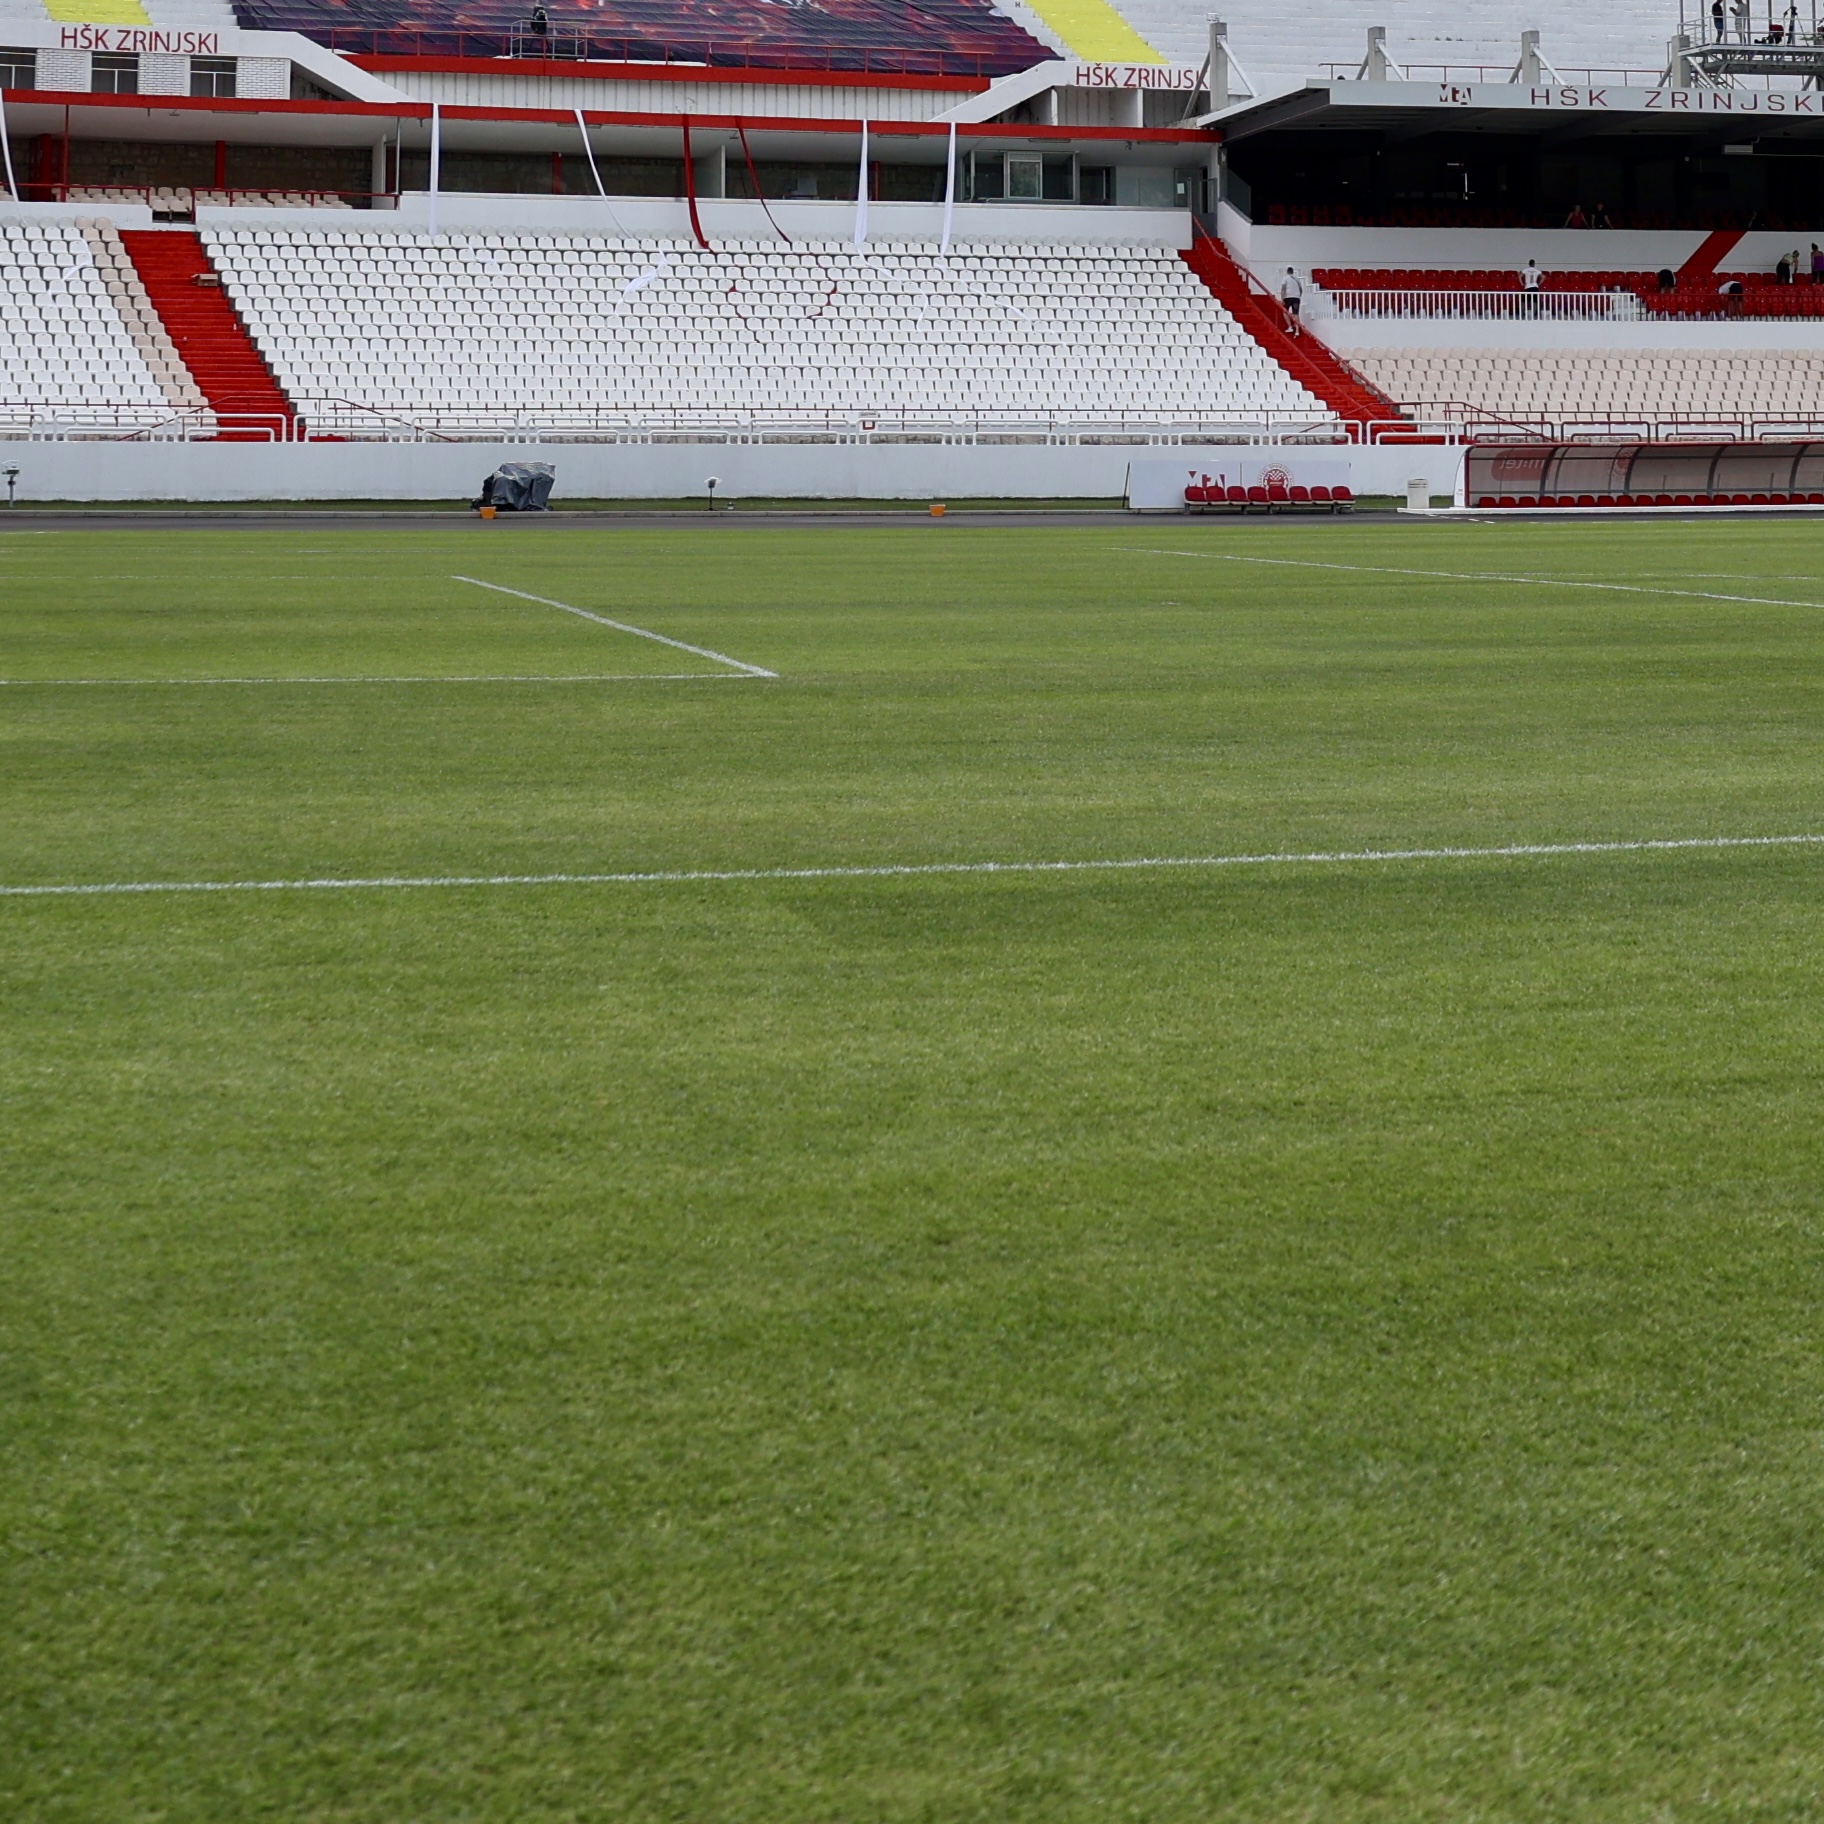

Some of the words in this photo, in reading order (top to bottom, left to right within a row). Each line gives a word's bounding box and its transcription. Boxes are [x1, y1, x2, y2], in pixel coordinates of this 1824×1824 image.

[61, 24, 110, 50] HŠK
[115, 29, 218, 54] ZRINJSKI
[1076, 62, 1118, 87] HŠK
[1123, 67, 1209, 89] ZRINJSK
[1530, 85, 1608, 107] HŠK
